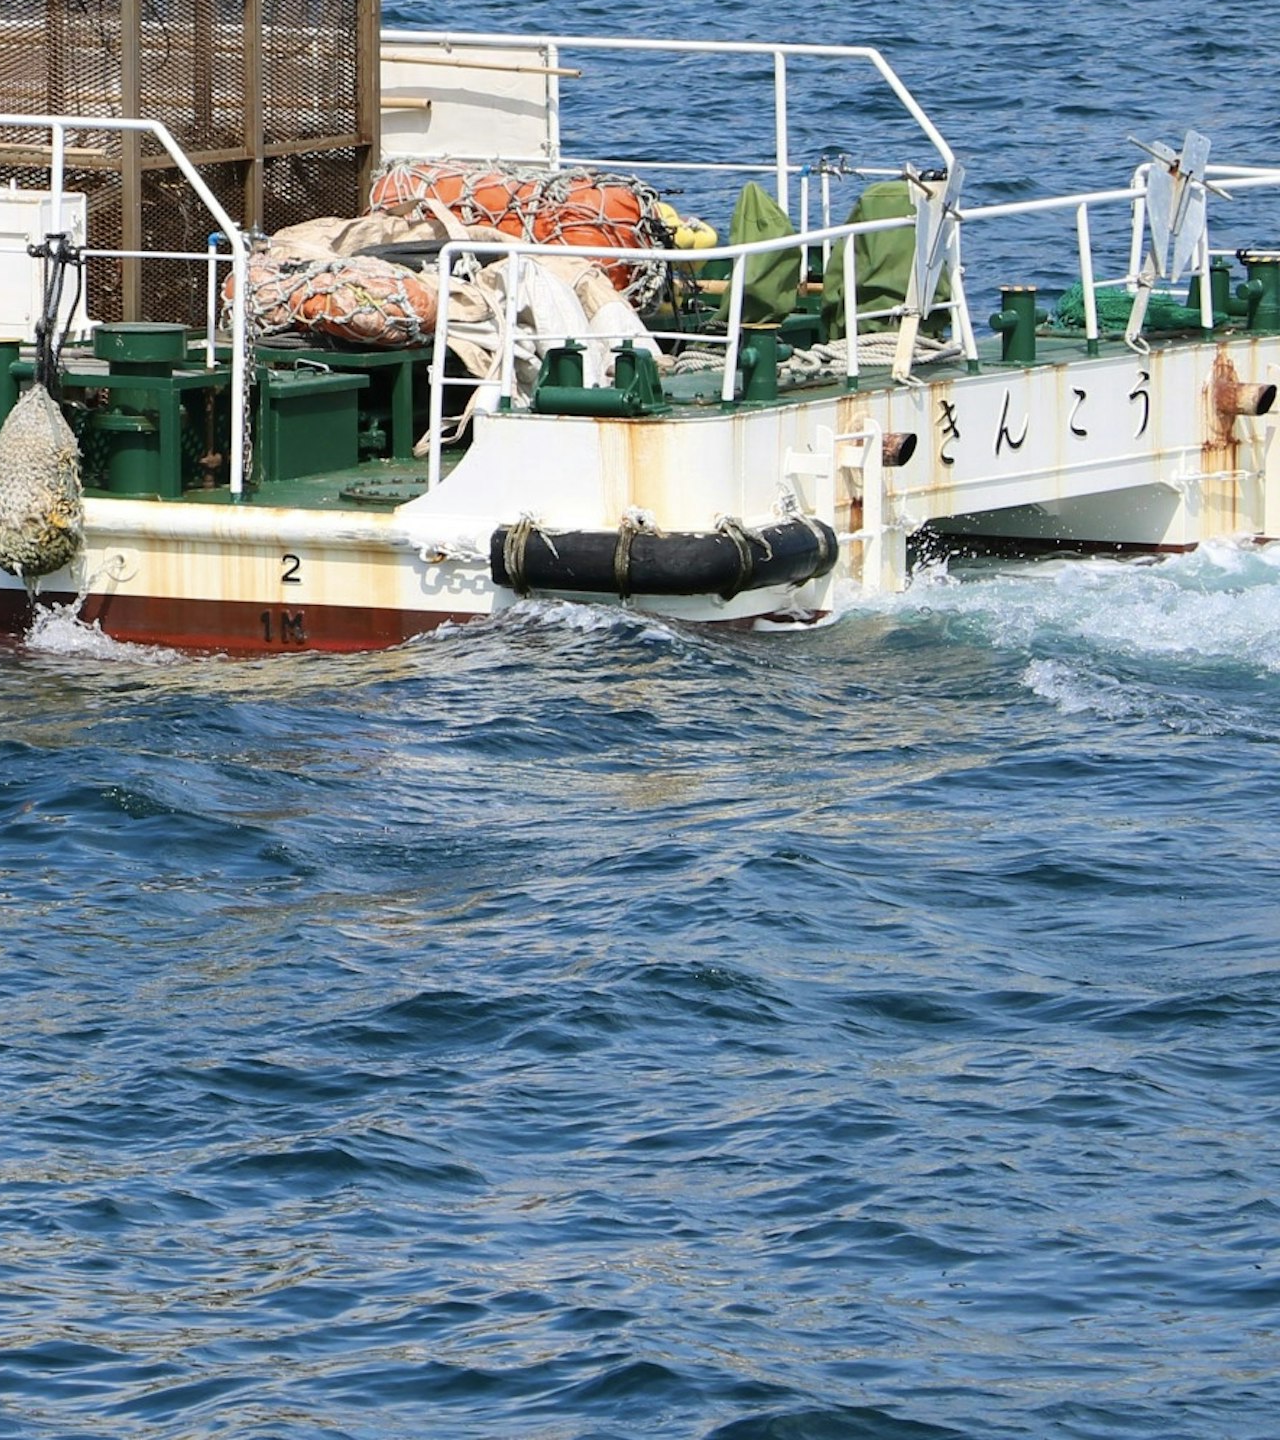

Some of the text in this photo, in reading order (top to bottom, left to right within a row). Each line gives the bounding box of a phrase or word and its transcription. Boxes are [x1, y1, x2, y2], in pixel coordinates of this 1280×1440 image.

[938, 368, 1151, 465] きんこう
[281, 554, 301, 583] 2
[260, 610, 306, 646] 1M
